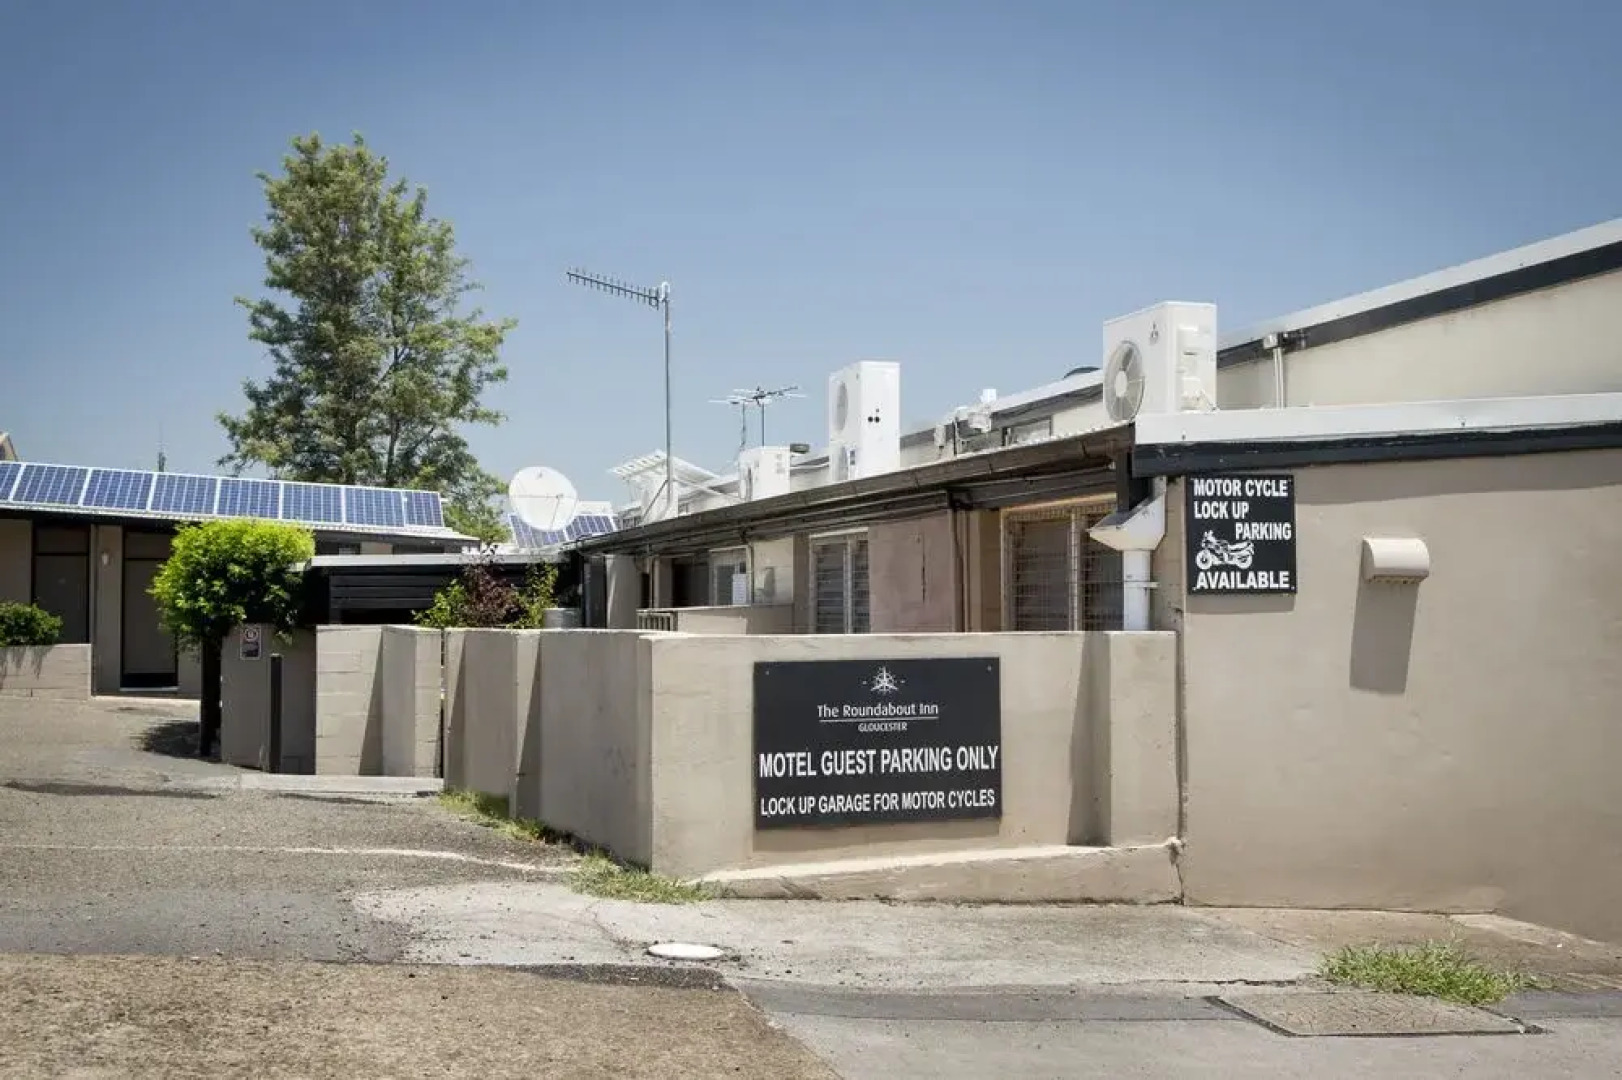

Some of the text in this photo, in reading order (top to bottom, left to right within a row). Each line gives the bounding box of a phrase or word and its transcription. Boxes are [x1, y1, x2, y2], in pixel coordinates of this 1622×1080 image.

[1193, 479, 1288, 496] MOTOR CYCLE
[1193, 501, 1249, 519] LOCK UP
[1235, 522, 1292, 540] PARKING
[1196, 571, 1290, 589] AVAILABLE
[817, 703, 939, 717] The Roundabout Inn
[858, 721, 908, 732] GLOUCESTER
[759, 745, 999, 778] MOTEL GUEST PARKING ONLY
[760, 789, 995, 816] LOCK UP GARAGE FOR MOTOR CYCLES
